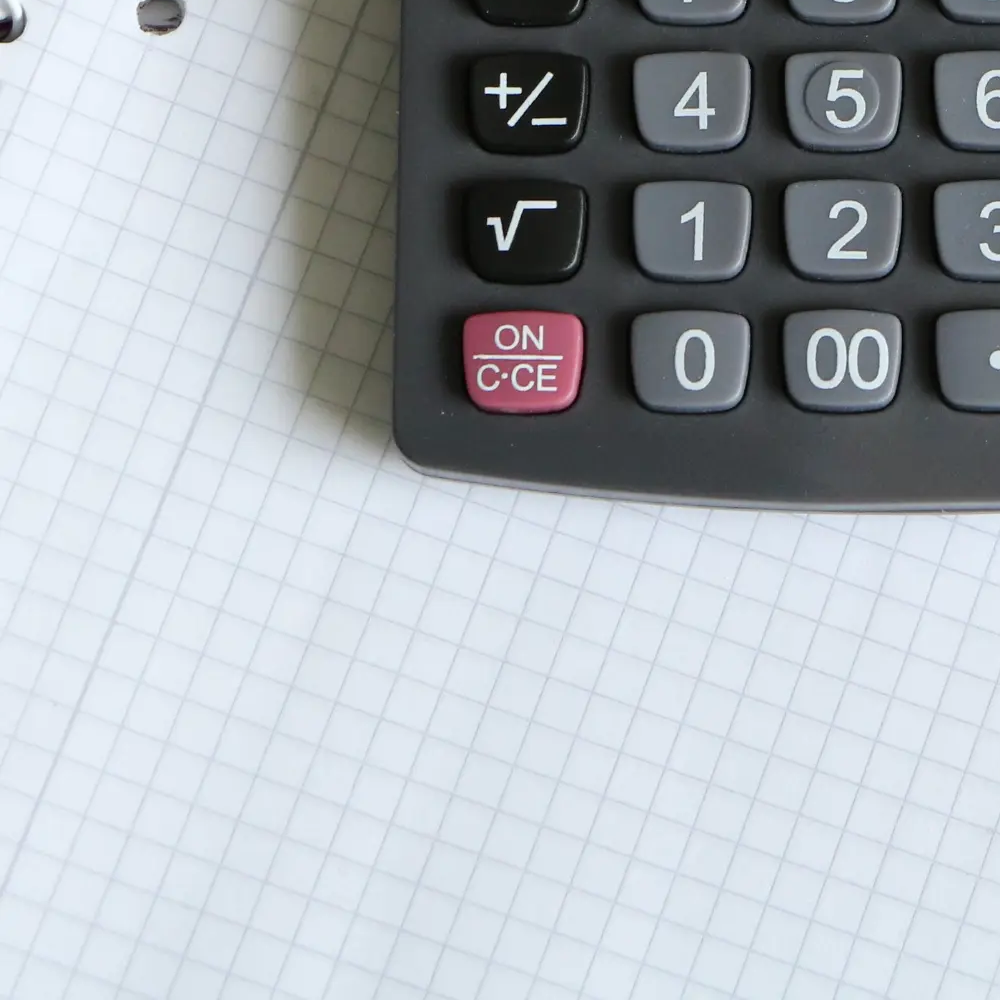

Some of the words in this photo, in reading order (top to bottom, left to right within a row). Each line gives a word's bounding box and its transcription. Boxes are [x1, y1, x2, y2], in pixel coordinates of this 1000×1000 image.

[673, 71, 716, 130] 4
[825, 68, 867, 129] 5
[680, 201, 705, 261] 1
[826, 200, 868, 260] 2
[494, 324, 544, 351] ON
[674, 328, 716, 391] 0
[806, 327, 890, 391] 00
